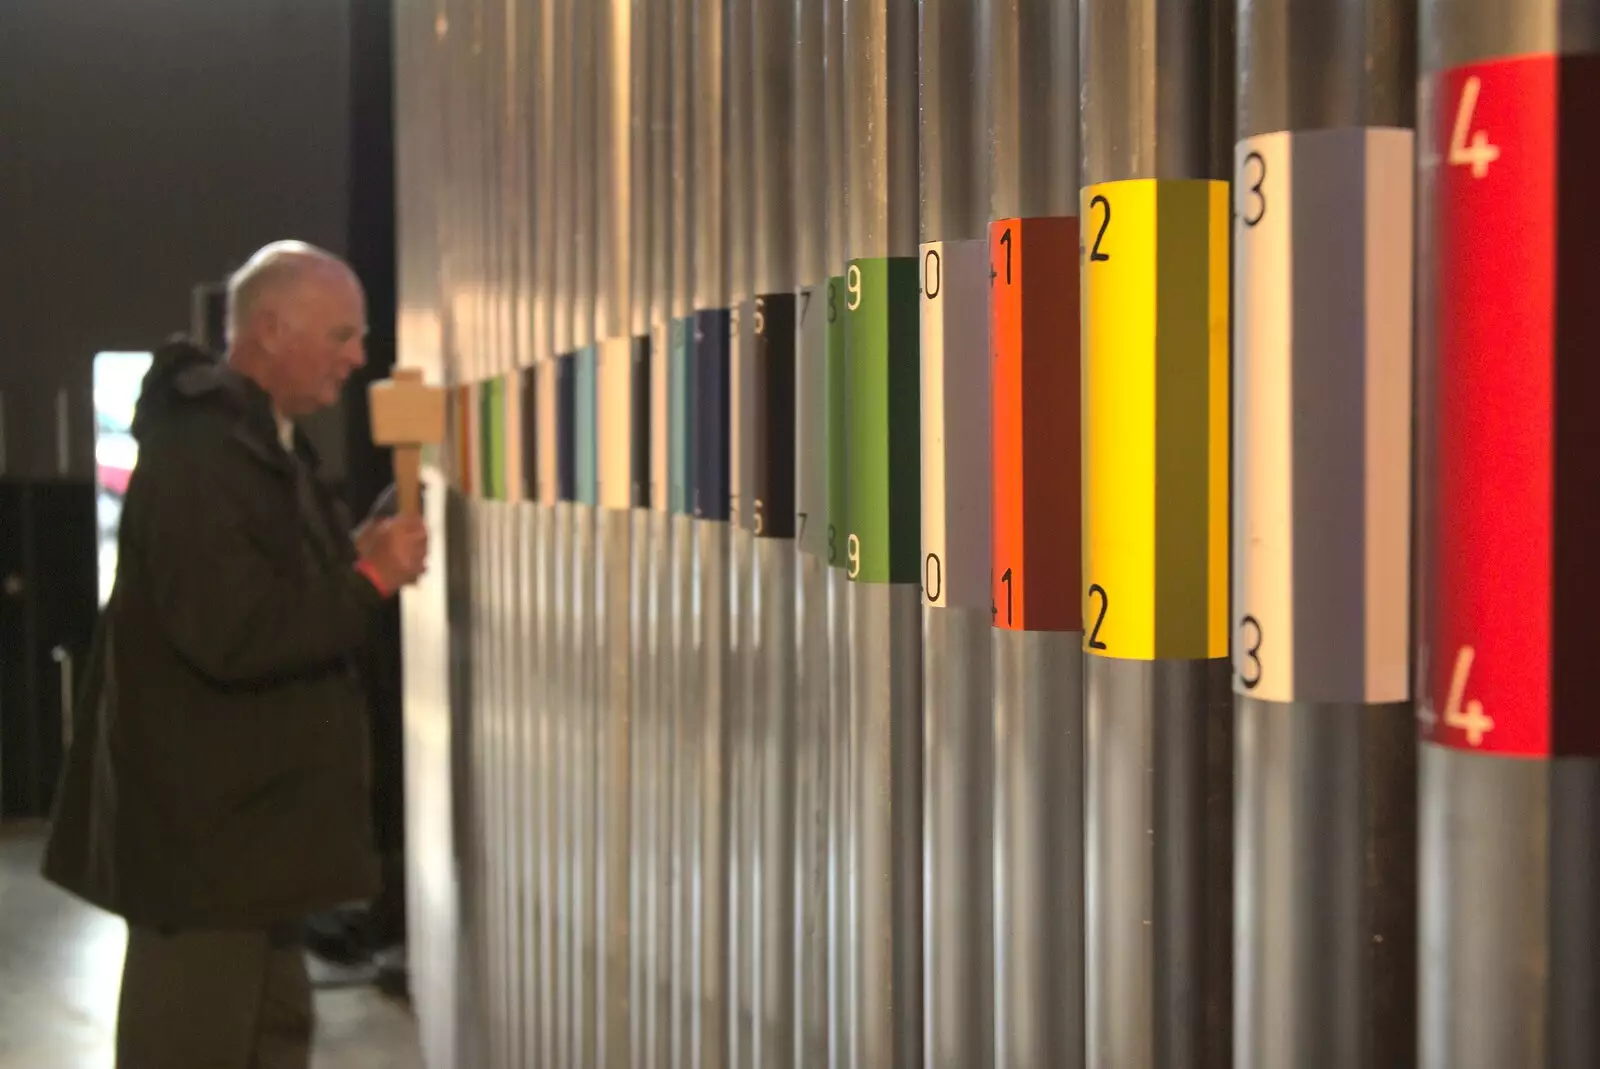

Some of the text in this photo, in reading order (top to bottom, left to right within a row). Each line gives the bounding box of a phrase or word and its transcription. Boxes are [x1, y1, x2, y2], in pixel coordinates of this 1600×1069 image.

[1241, 151, 1266, 226] 3
[1081, 195, 1111, 262] 2
[847, 264, 861, 311] 9
[920, 249, 941, 299] 0
[847, 533, 860, 578] 9
[920, 552, 941, 602] 0
[1083, 583, 1108, 650] 2
[1239, 614, 1262, 689] 3
